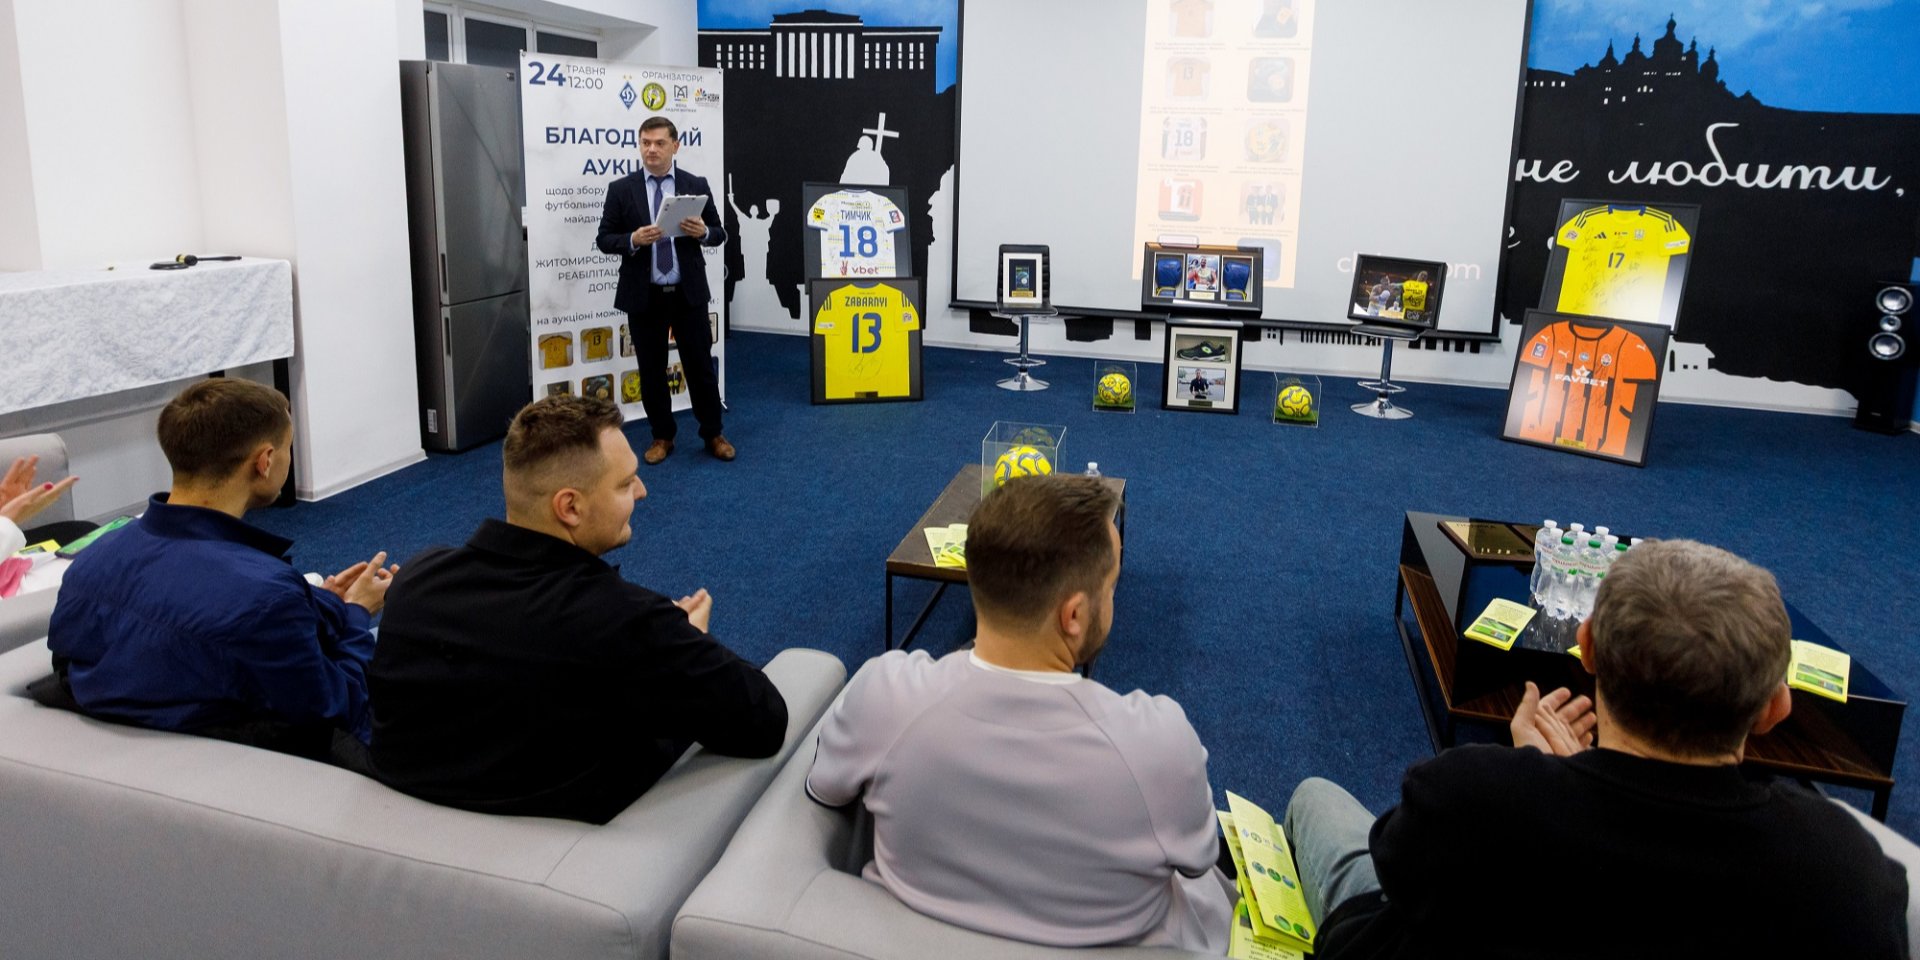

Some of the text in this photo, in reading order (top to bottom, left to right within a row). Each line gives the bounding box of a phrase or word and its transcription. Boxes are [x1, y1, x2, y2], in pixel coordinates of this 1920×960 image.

[528, 62, 606, 87] 24 ТРАВНЯ
[568, 76, 604, 90] 12:00
[545, 126, 702, 148] БЛАГОДИЙ
[1174, 130, 1194, 147] 18
[1515, 122, 1905, 198] не любити,
[582, 158, 677, 176] АУКЦ
[545, 185, 605, 196] щодо збору
[544, 200, 605, 212] футбольног
[564, 214, 602, 224] майдан
[840, 210, 872, 221] ТИМЧИК
[839, 224, 878, 258] 18
[535, 255, 622, 268] ЖИТОМИРСЬКО
[1608, 252, 1625, 269] 17
[558, 268, 620, 281] РЕАБІЛІТАЦ
[852, 266, 879, 275] vbet
[588, 281, 618, 293] ДОПО
[845, 296, 887, 307] ZABARNYI
[536, 317, 549, 325] на
[551, 312, 593, 325] аукціоні
[852, 312, 881, 353] 13
[1554, 373, 1608, 388] FAVBET
